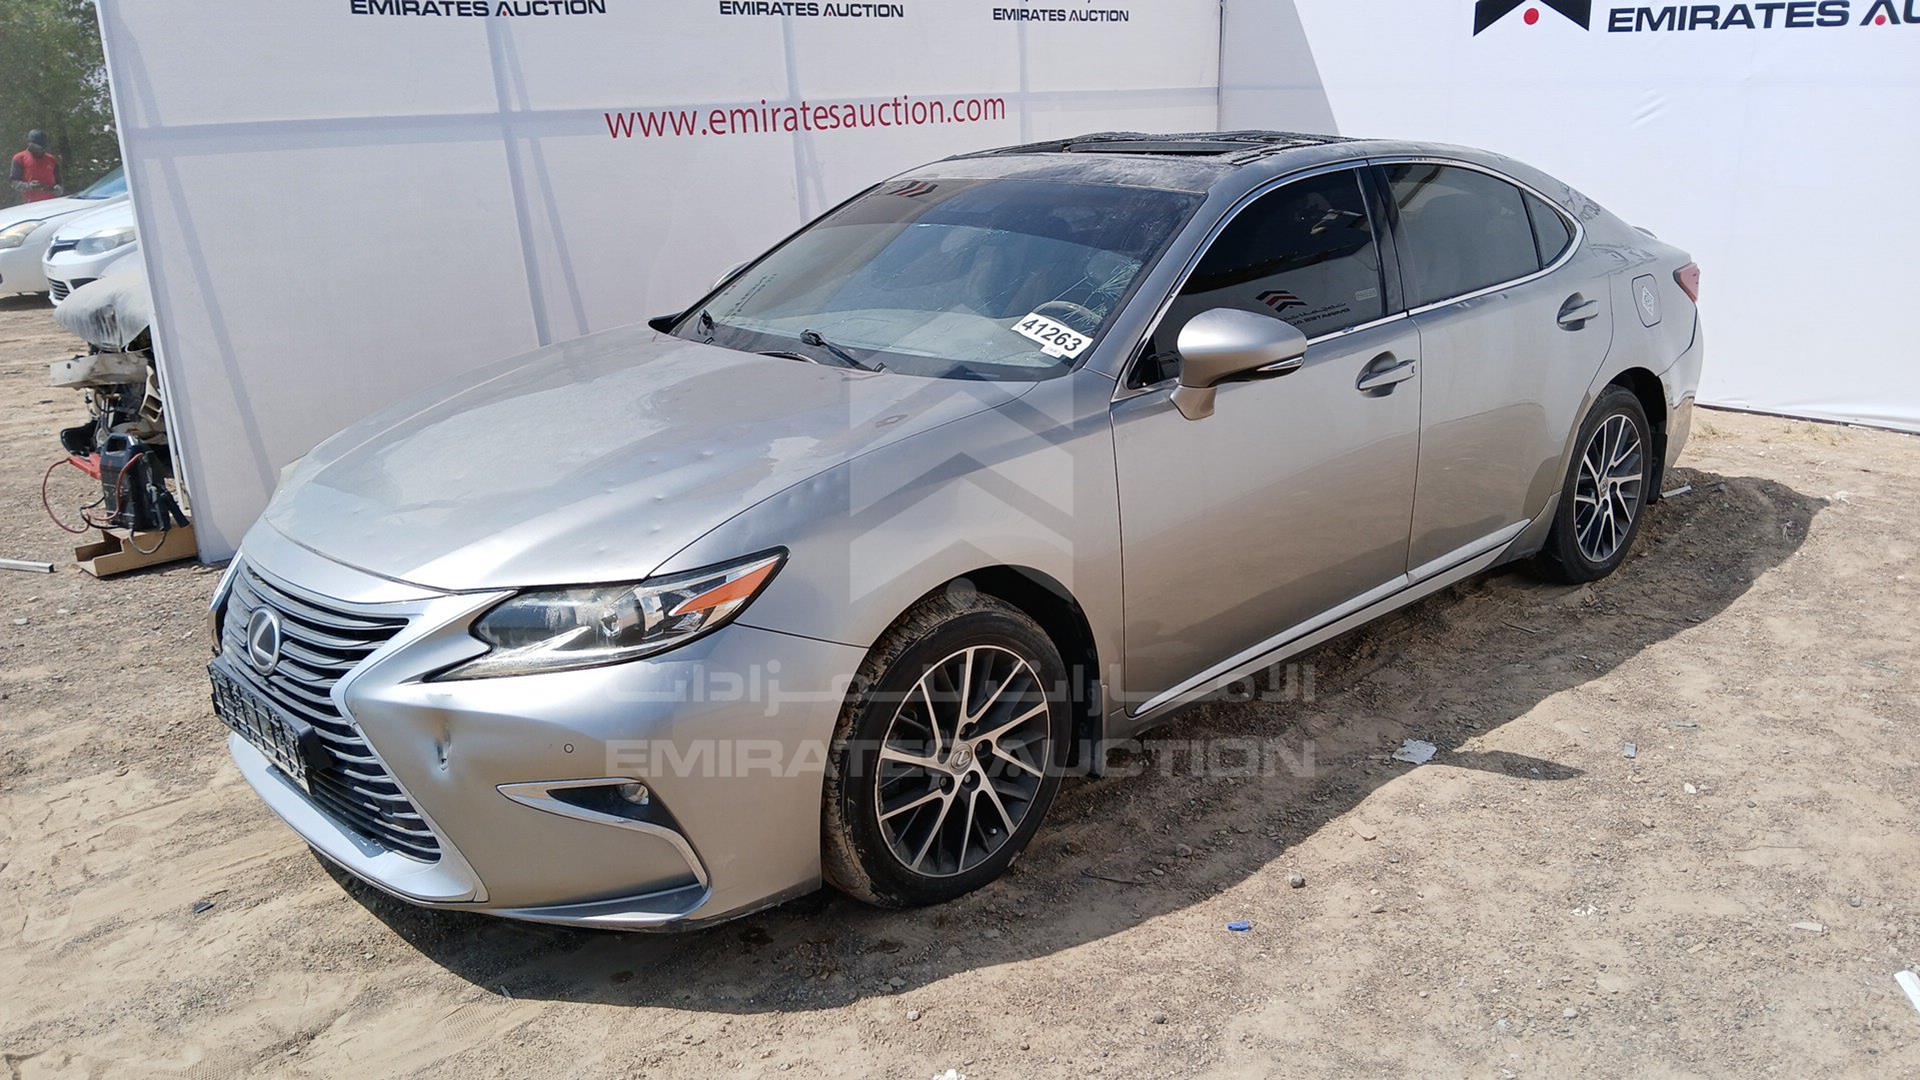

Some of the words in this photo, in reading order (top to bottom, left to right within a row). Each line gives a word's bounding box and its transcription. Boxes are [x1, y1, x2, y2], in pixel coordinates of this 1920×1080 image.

[351, 0, 489, 17] EMIRATES
[495, 0, 606, 17] AUCTION
[719, 0, 819, 16] EMIRATES
[823, 3, 904, 17] AUCTION
[993, 8, 1066, 21] EMIRATES
[1069, 10, 1129, 21] AUCTION
[1608, 0, 1850, 32] EMIRATES
[604, 95, 1006, 139] www.emiratesauction.com
[1022, 319, 1082, 351] 41263
